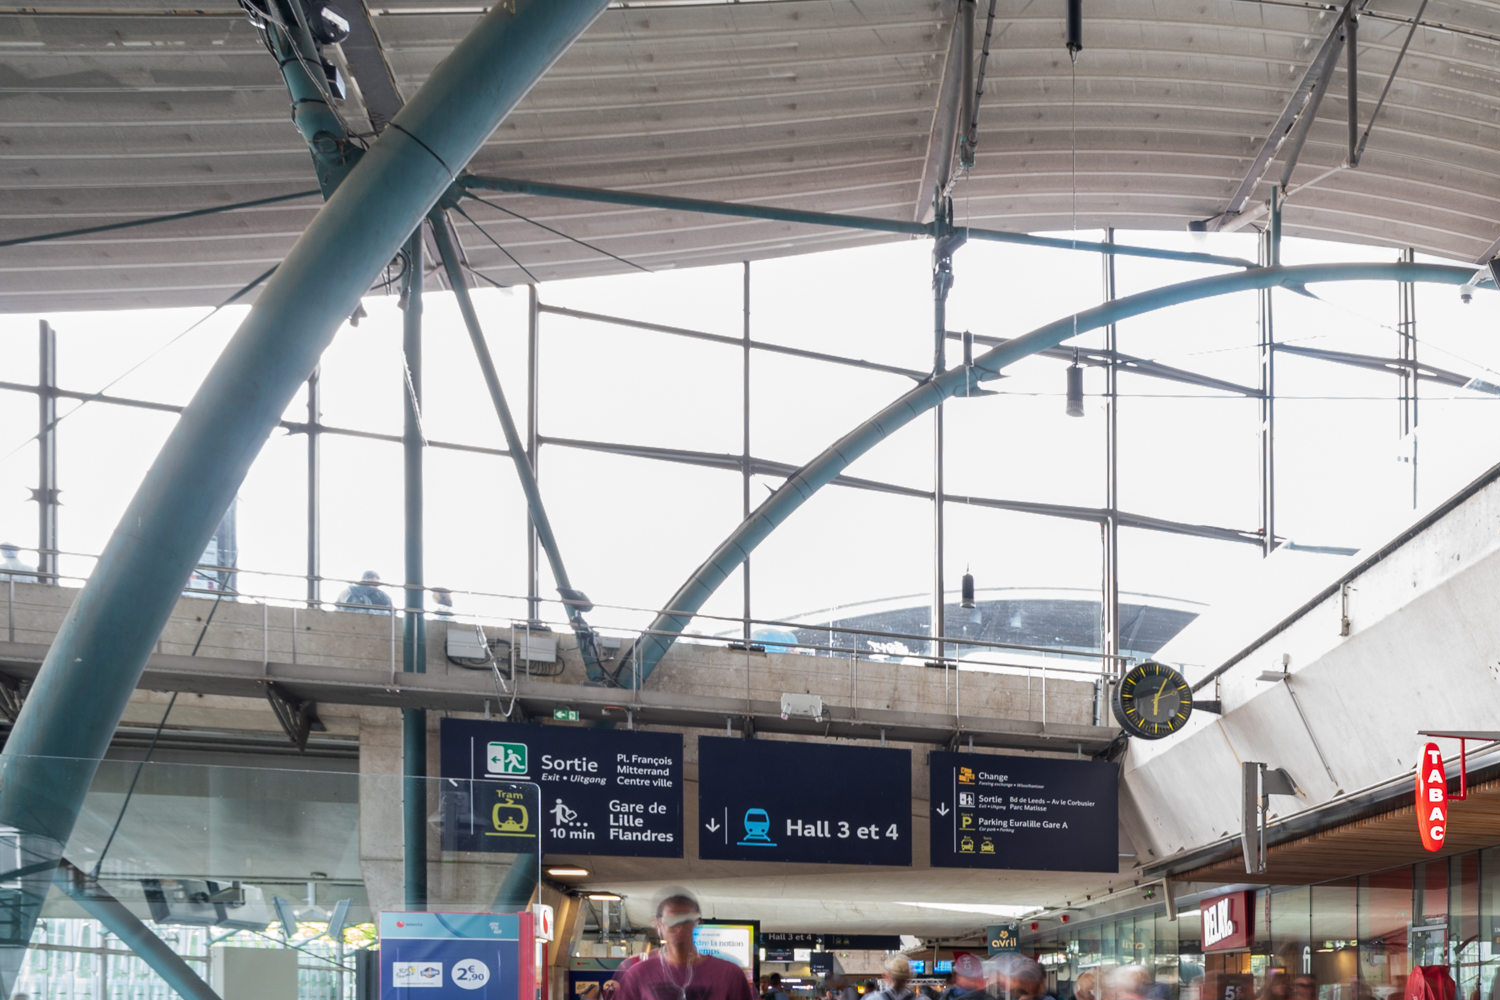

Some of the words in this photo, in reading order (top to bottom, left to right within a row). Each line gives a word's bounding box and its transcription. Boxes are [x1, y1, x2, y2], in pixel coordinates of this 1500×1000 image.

[541, 754, 599, 772] Sortie
[617, 753, 630, 764] Pl.
[631, 754, 673, 767] François
[617, 765, 670, 777] Mitterrand
[978, 771, 1009, 782] Change
[541, 772, 560, 782] Exit
[570, 774, 607, 786] Uitgang
[617, 776, 651, 787] Centre
[652, 778, 673, 788] ville
[496, 789, 523, 800] Tram
[978, 794, 1003, 803] Sortie
[1427, 750, 1444, 841] TABAC
[608, 799, 645, 814] Gare
[648, 802, 667, 814] de
[1067, 799, 1095, 807] Corbusier
[609, 813, 644, 827] Lille
[978, 817, 1008, 828] Parking
[1009, 819, 1041, 828] Euralille
[1042, 820, 1061, 829] Gare
[1061, 821, 1069, 829] A
[550, 828, 566, 839] 10
[569, 828, 596, 840] min
[609, 827, 674, 842] Flandres
[786, 819, 831, 838] Hall
[837, 821, 850, 839] 3
[857, 824, 880, 840] et
[885, 823, 899, 840] 4
[718, 939, 744, 947] notion
[768, 933, 786, 941] Hall
[797, 933, 805, 941] et
[991, 938, 1017, 948] avril
